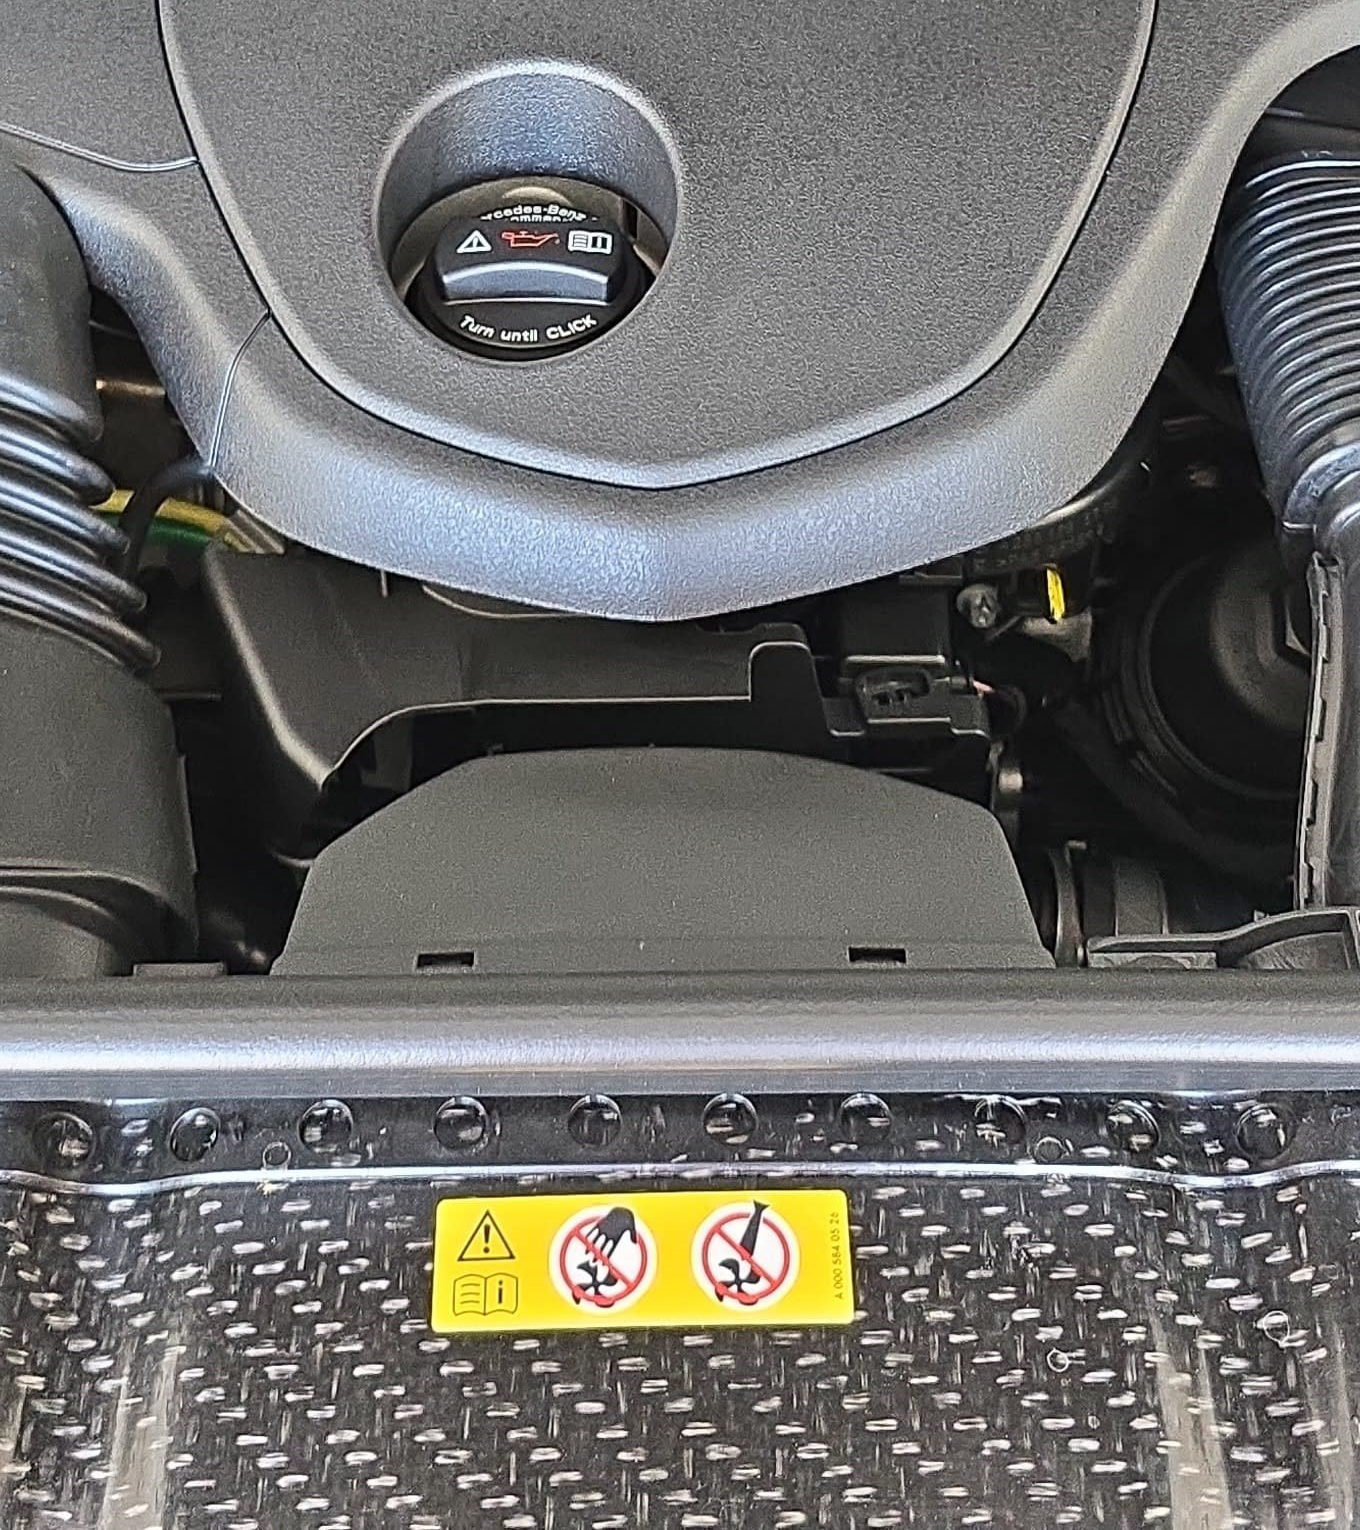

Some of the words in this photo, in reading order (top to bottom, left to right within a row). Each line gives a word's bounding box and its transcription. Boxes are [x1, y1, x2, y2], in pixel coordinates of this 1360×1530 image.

[480, 204, 587, 222] rcedes-Benz
[459, 314, 495, 339] Turn
[500, 328, 538, 343] until
[546, 313, 597, 340] CLICK
[830, 1228, 840, 1241] 05
[831, 1245, 842, 1265] 584
[832, 1267, 844, 1289] 000
[834, 1291, 844, 1300] A
